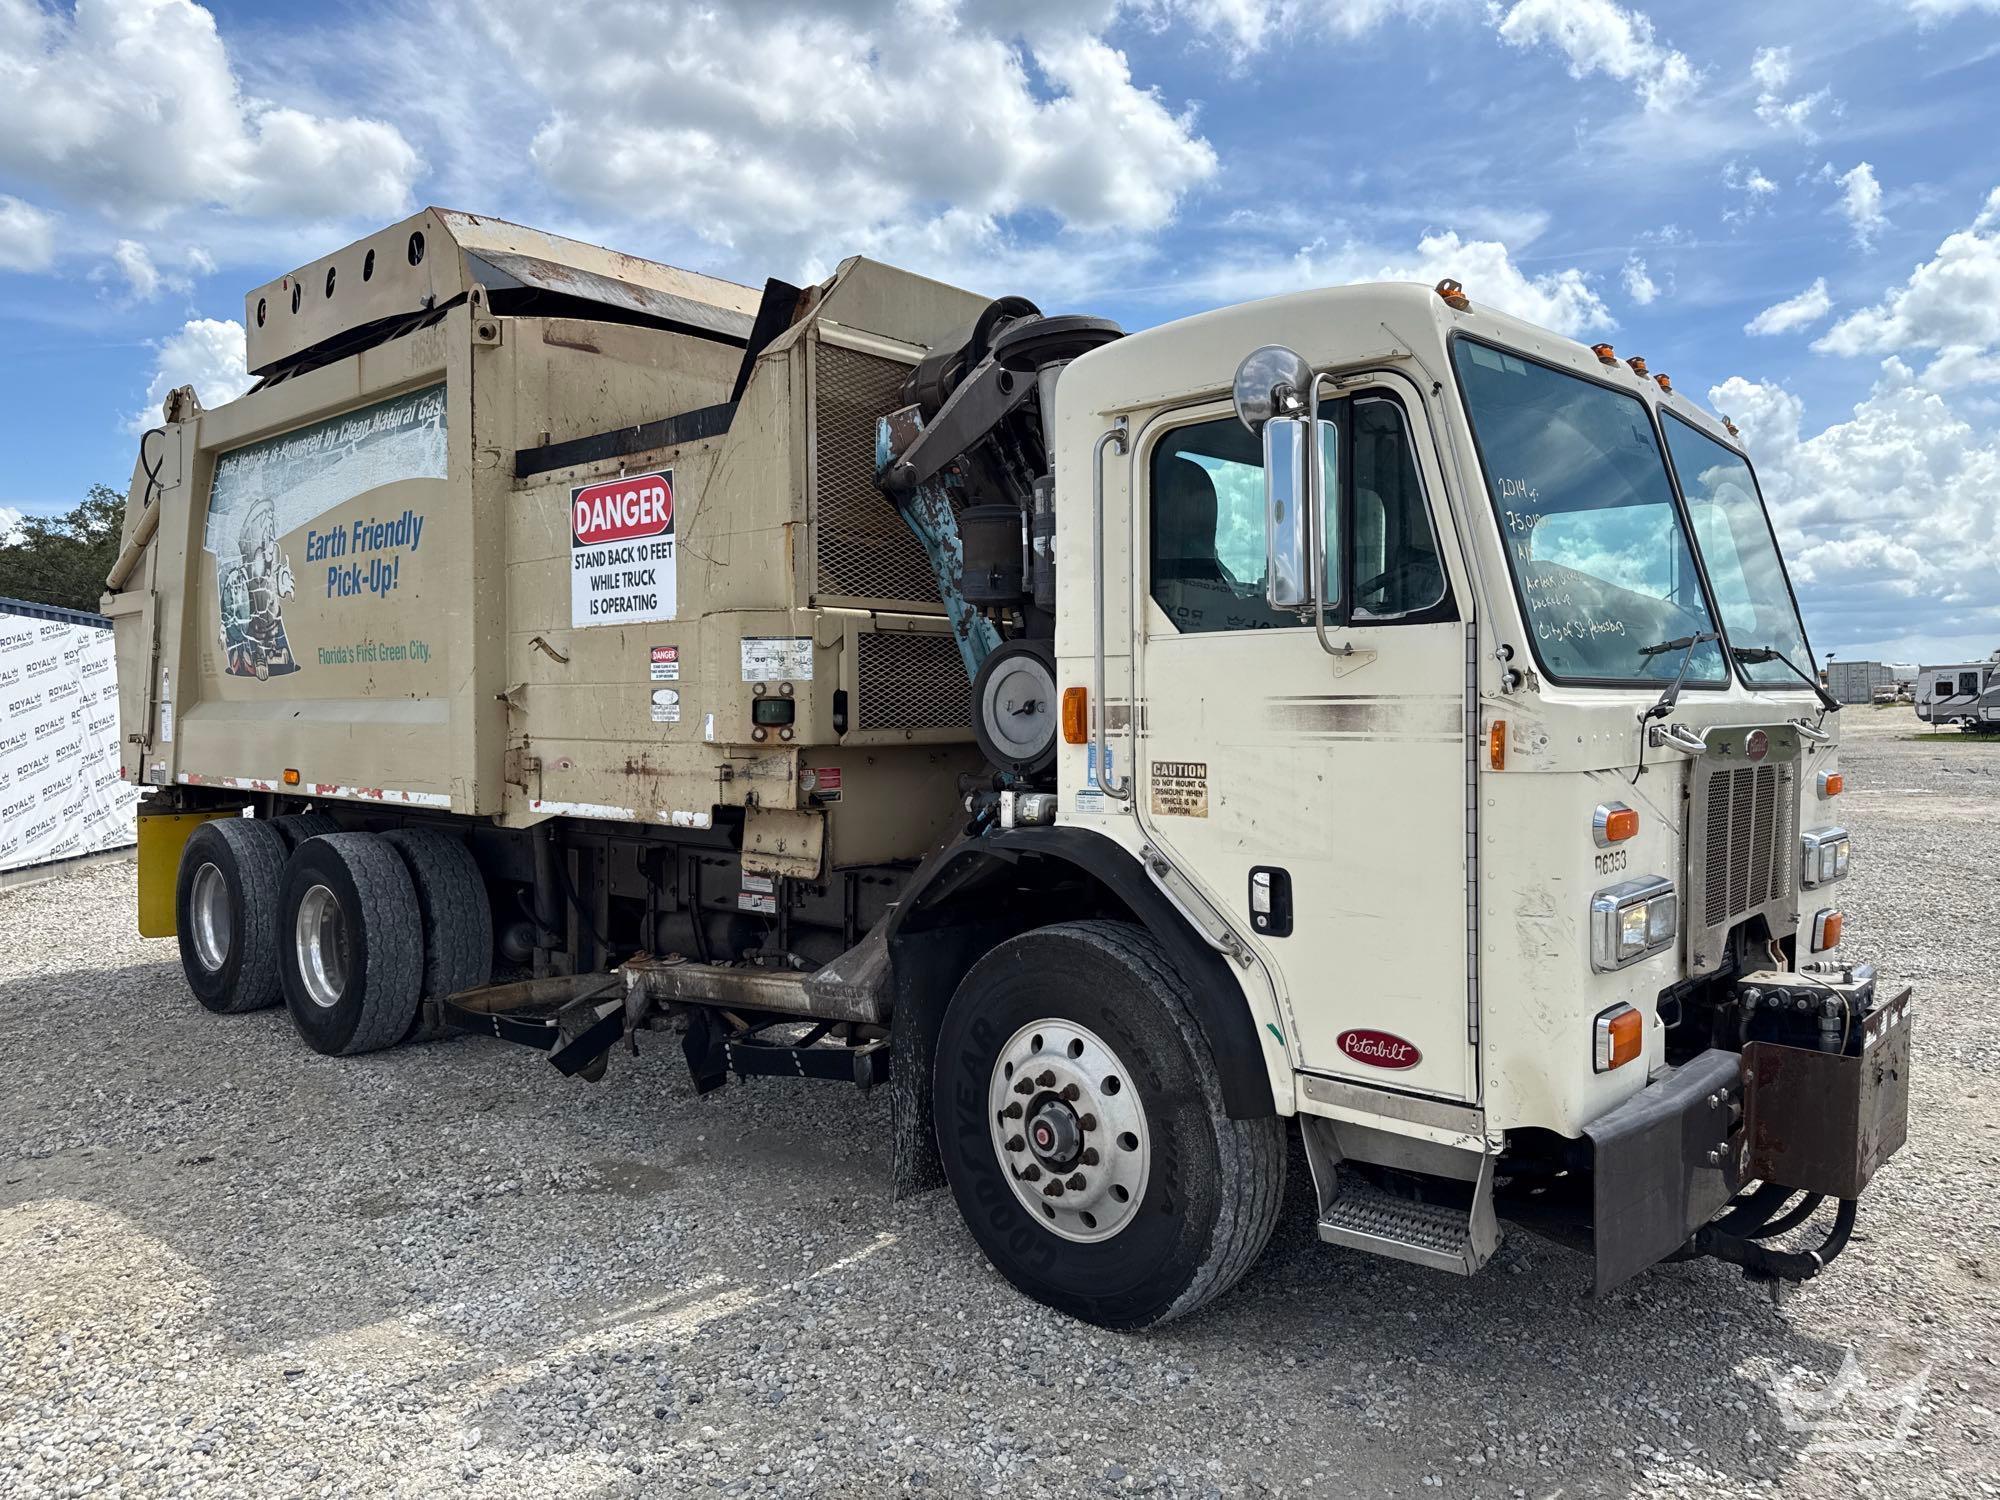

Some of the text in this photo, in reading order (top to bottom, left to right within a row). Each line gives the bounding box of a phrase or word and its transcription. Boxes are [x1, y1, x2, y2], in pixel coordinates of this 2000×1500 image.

[324, 427, 338, 450] by
[340, 420, 370, 442] Clean
[372, 402, 416, 432] Natural
[1498, 478, 1527, 498] 2014
[577, 487, 667, 534] DANGER
[306, 510, 424, 562] Earth Friendly
[575, 542, 673, 570] STAND BACK 10 FEET
[328, 556, 399, 598] Pick-Up!
[590, 569, 656, 591] WHILE TRUCK
[1525, 575, 1539, 593] Air
[590, 594, 657, 615] IS OPERATING
[1531, 595, 1560, 612] Locked
[1539, 621, 1562, 641] City
[1563, 622, 1573, 638] of
[318, 640, 431, 665] Florida's First Green City.
[652, 650, 675, 660] DANGER
[1154, 763, 1205, 778] CAUTION
[1168, 807, 1190, 815] MOTION
[1346, 1034, 1411, 1060] Peterbilt
